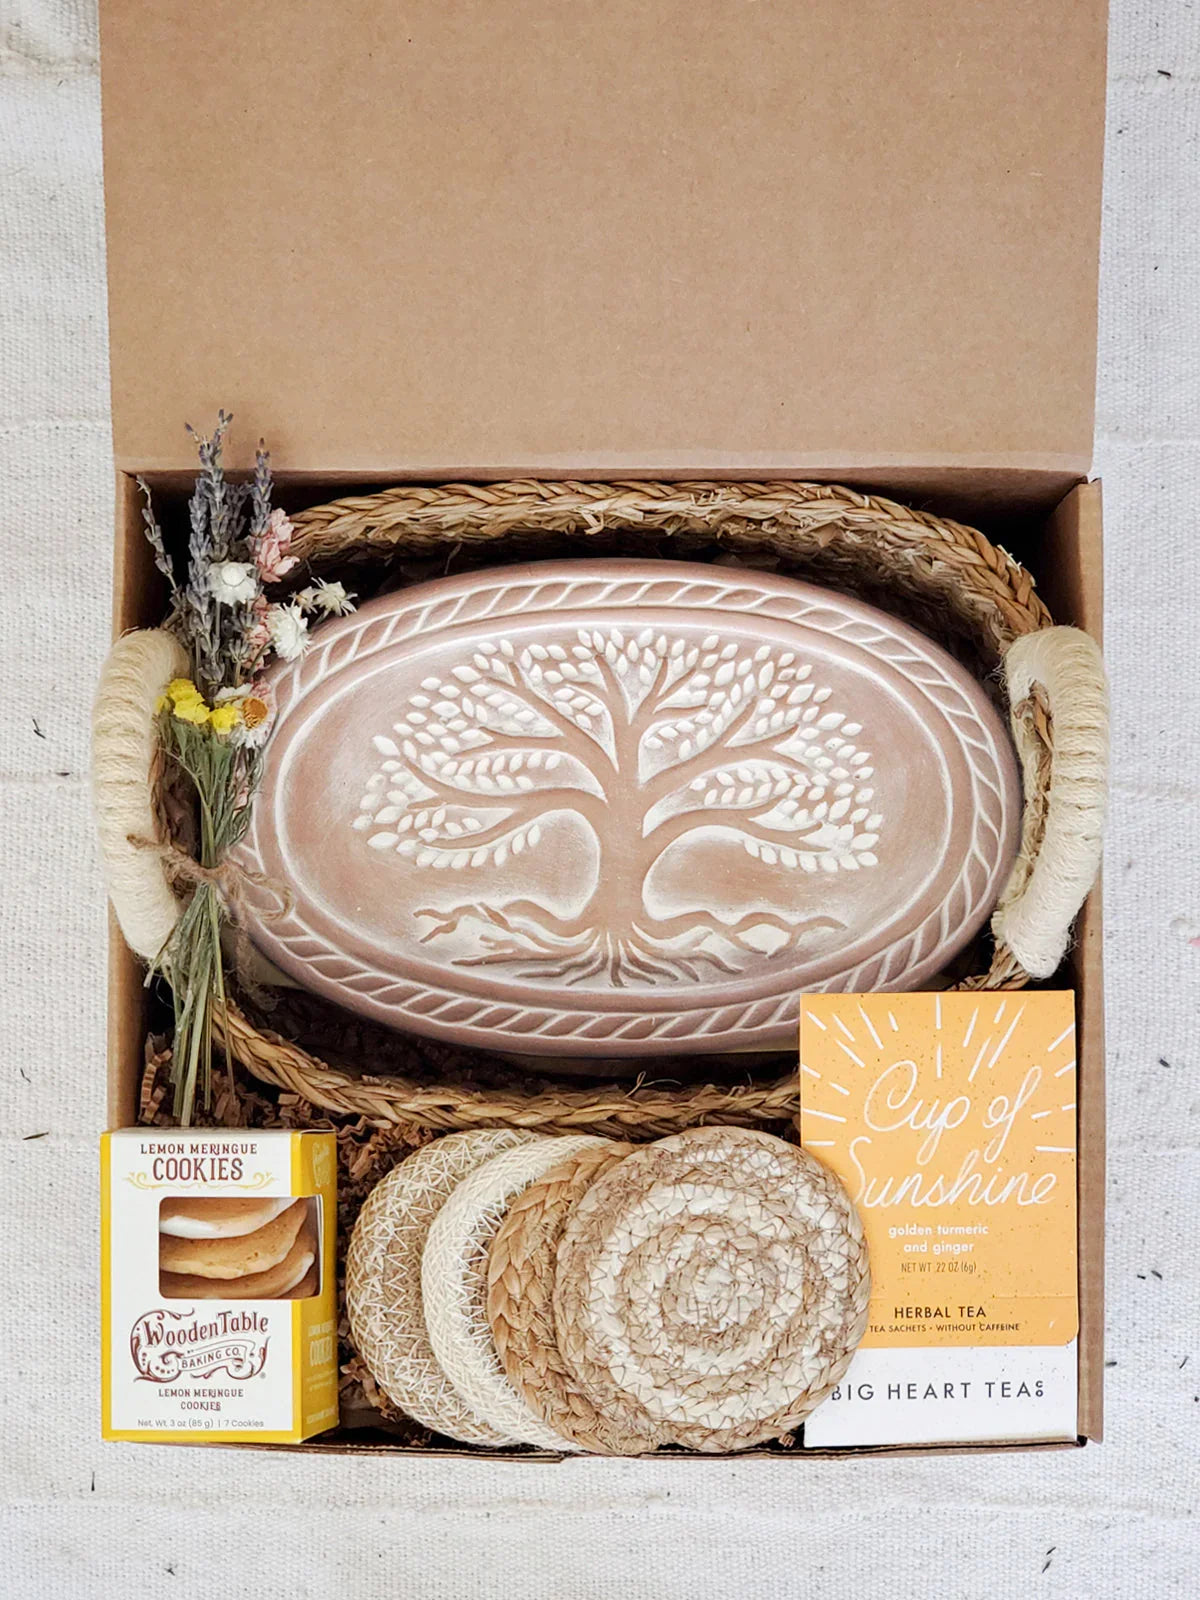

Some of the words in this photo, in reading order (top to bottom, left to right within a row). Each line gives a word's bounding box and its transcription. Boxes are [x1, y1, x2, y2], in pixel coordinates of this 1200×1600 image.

[864, 1059, 970, 1165] Cup
[982, 1066, 1042, 1163] of
[140, 1143, 185, 1154] LEMON
[190, 1143, 257, 1155] MERINGUE
[153, 1157, 243, 1182] COOKIES
[848, 1136, 1057, 1208] Sunshine
[888, 1223, 932, 1239] golden
[937, 1223, 989, 1235] turmeric
[903, 1240, 928, 1252] and
[933, 1240, 975, 1255] ginger
[901, 1262, 917, 1273] NET
[961, 1261, 977, 1274] (6g)
[894, 1306, 951, 1319] HERBAL
[958, 1306, 987, 1318] TEA
[870, 1325, 886, 1333] TEA
[889, 1324, 927, 1332] SACHETS
[935, 1323, 976, 1332] WITHOUT
[979, 1322, 1020, 1331] CAFFEINE
[181, 1350, 222, 1369] BAKING
[158, 1388, 191, 1398] LEMON
[193, 1388, 244, 1398] MERINGUE
[831, 1383, 875, 1401] BIG
[887, 1382, 971, 1400] HEART
[180, 1401, 222, 1412] COOKIES
[170, 1419, 176, 1428] 3
[177, 1420, 186, 1428] oz
[224, 1419, 230, 1428] 7
[231, 1418, 265, 1428] Cookies
